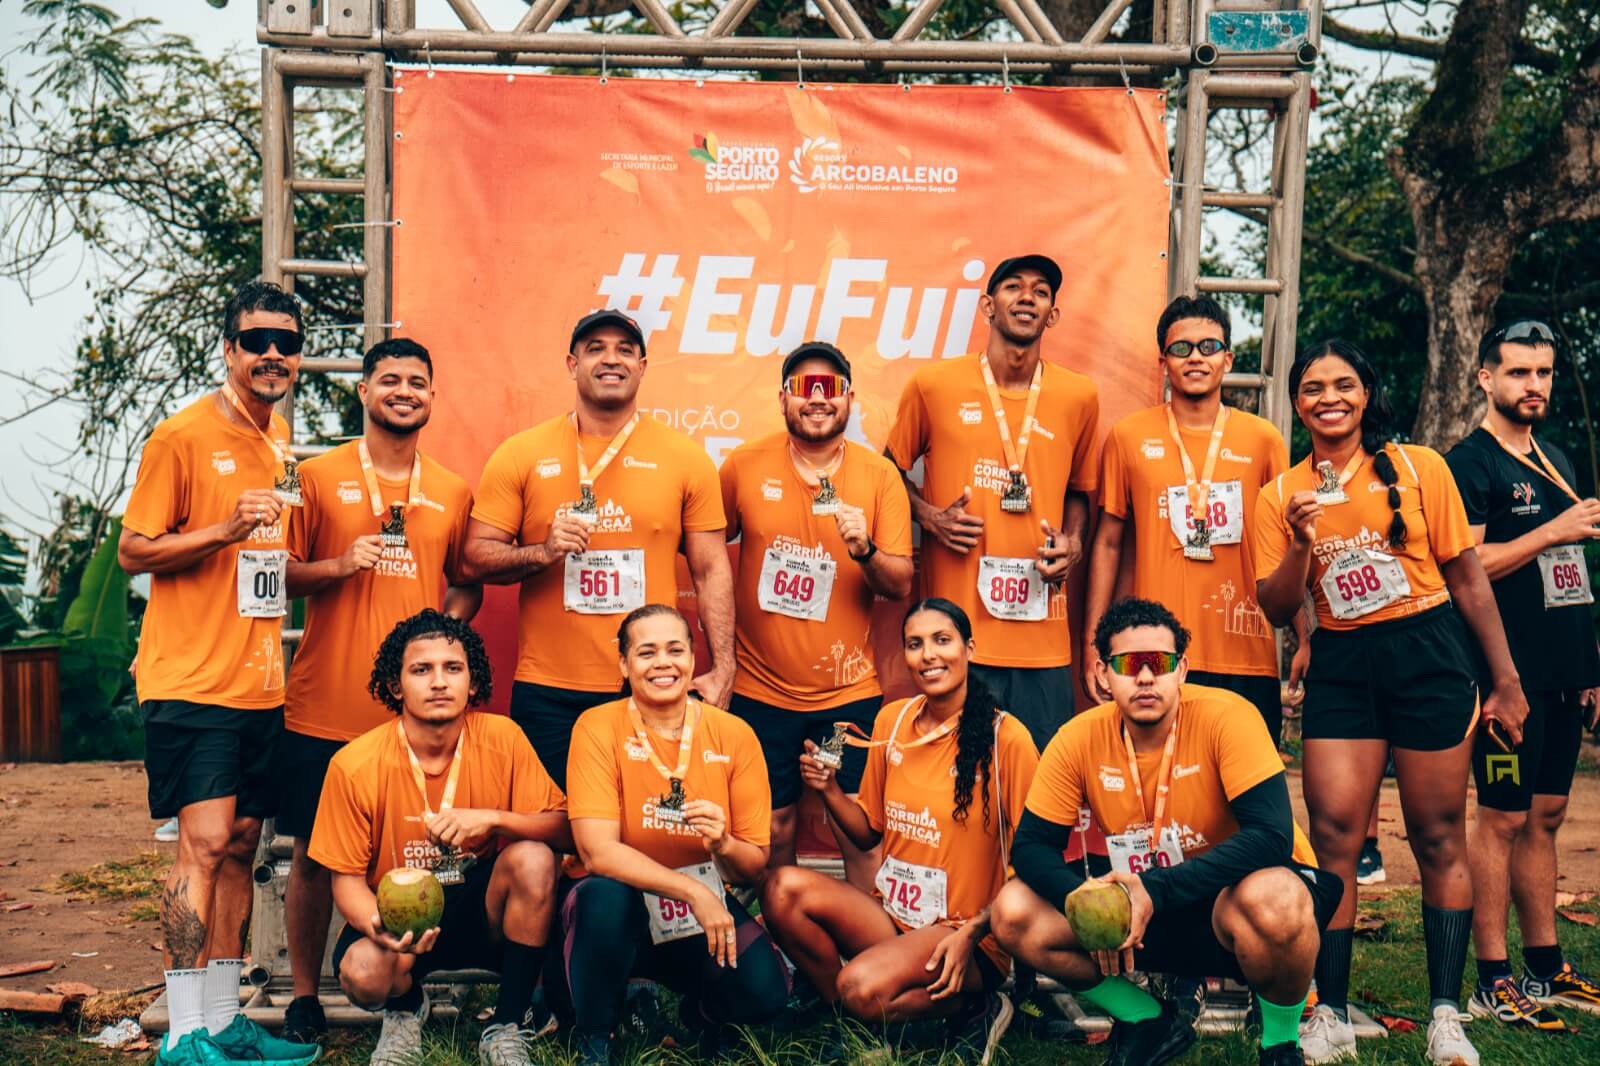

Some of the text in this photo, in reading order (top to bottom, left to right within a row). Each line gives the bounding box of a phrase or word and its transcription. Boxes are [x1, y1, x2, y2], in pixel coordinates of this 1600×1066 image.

[717, 146, 780, 165] PORTO
[704, 162, 779, 181] SEGURO
[811, 164, 959, 183] ARCOBALENO
[590, 252, 985, 360] #EuFui
[382, 547, 413, 560] RIDA
[773, 540, 831, 561] CORRIDA
[1313, 529, 1382, 556] CORRIDA
[254, 571, 280, 599] 00
[580, 569, 620, 597] 561
[773, 569, 815, 602] 649
[991, 576, 1029, 604] 869
[1335, 564, 1381, 602] 598
[1553, 563, 1582, 590] 696
[885, 805, 938, 830] CORRIDA
[886, 876, 922, 912] 742
[658, 895, 693, 922] 59
